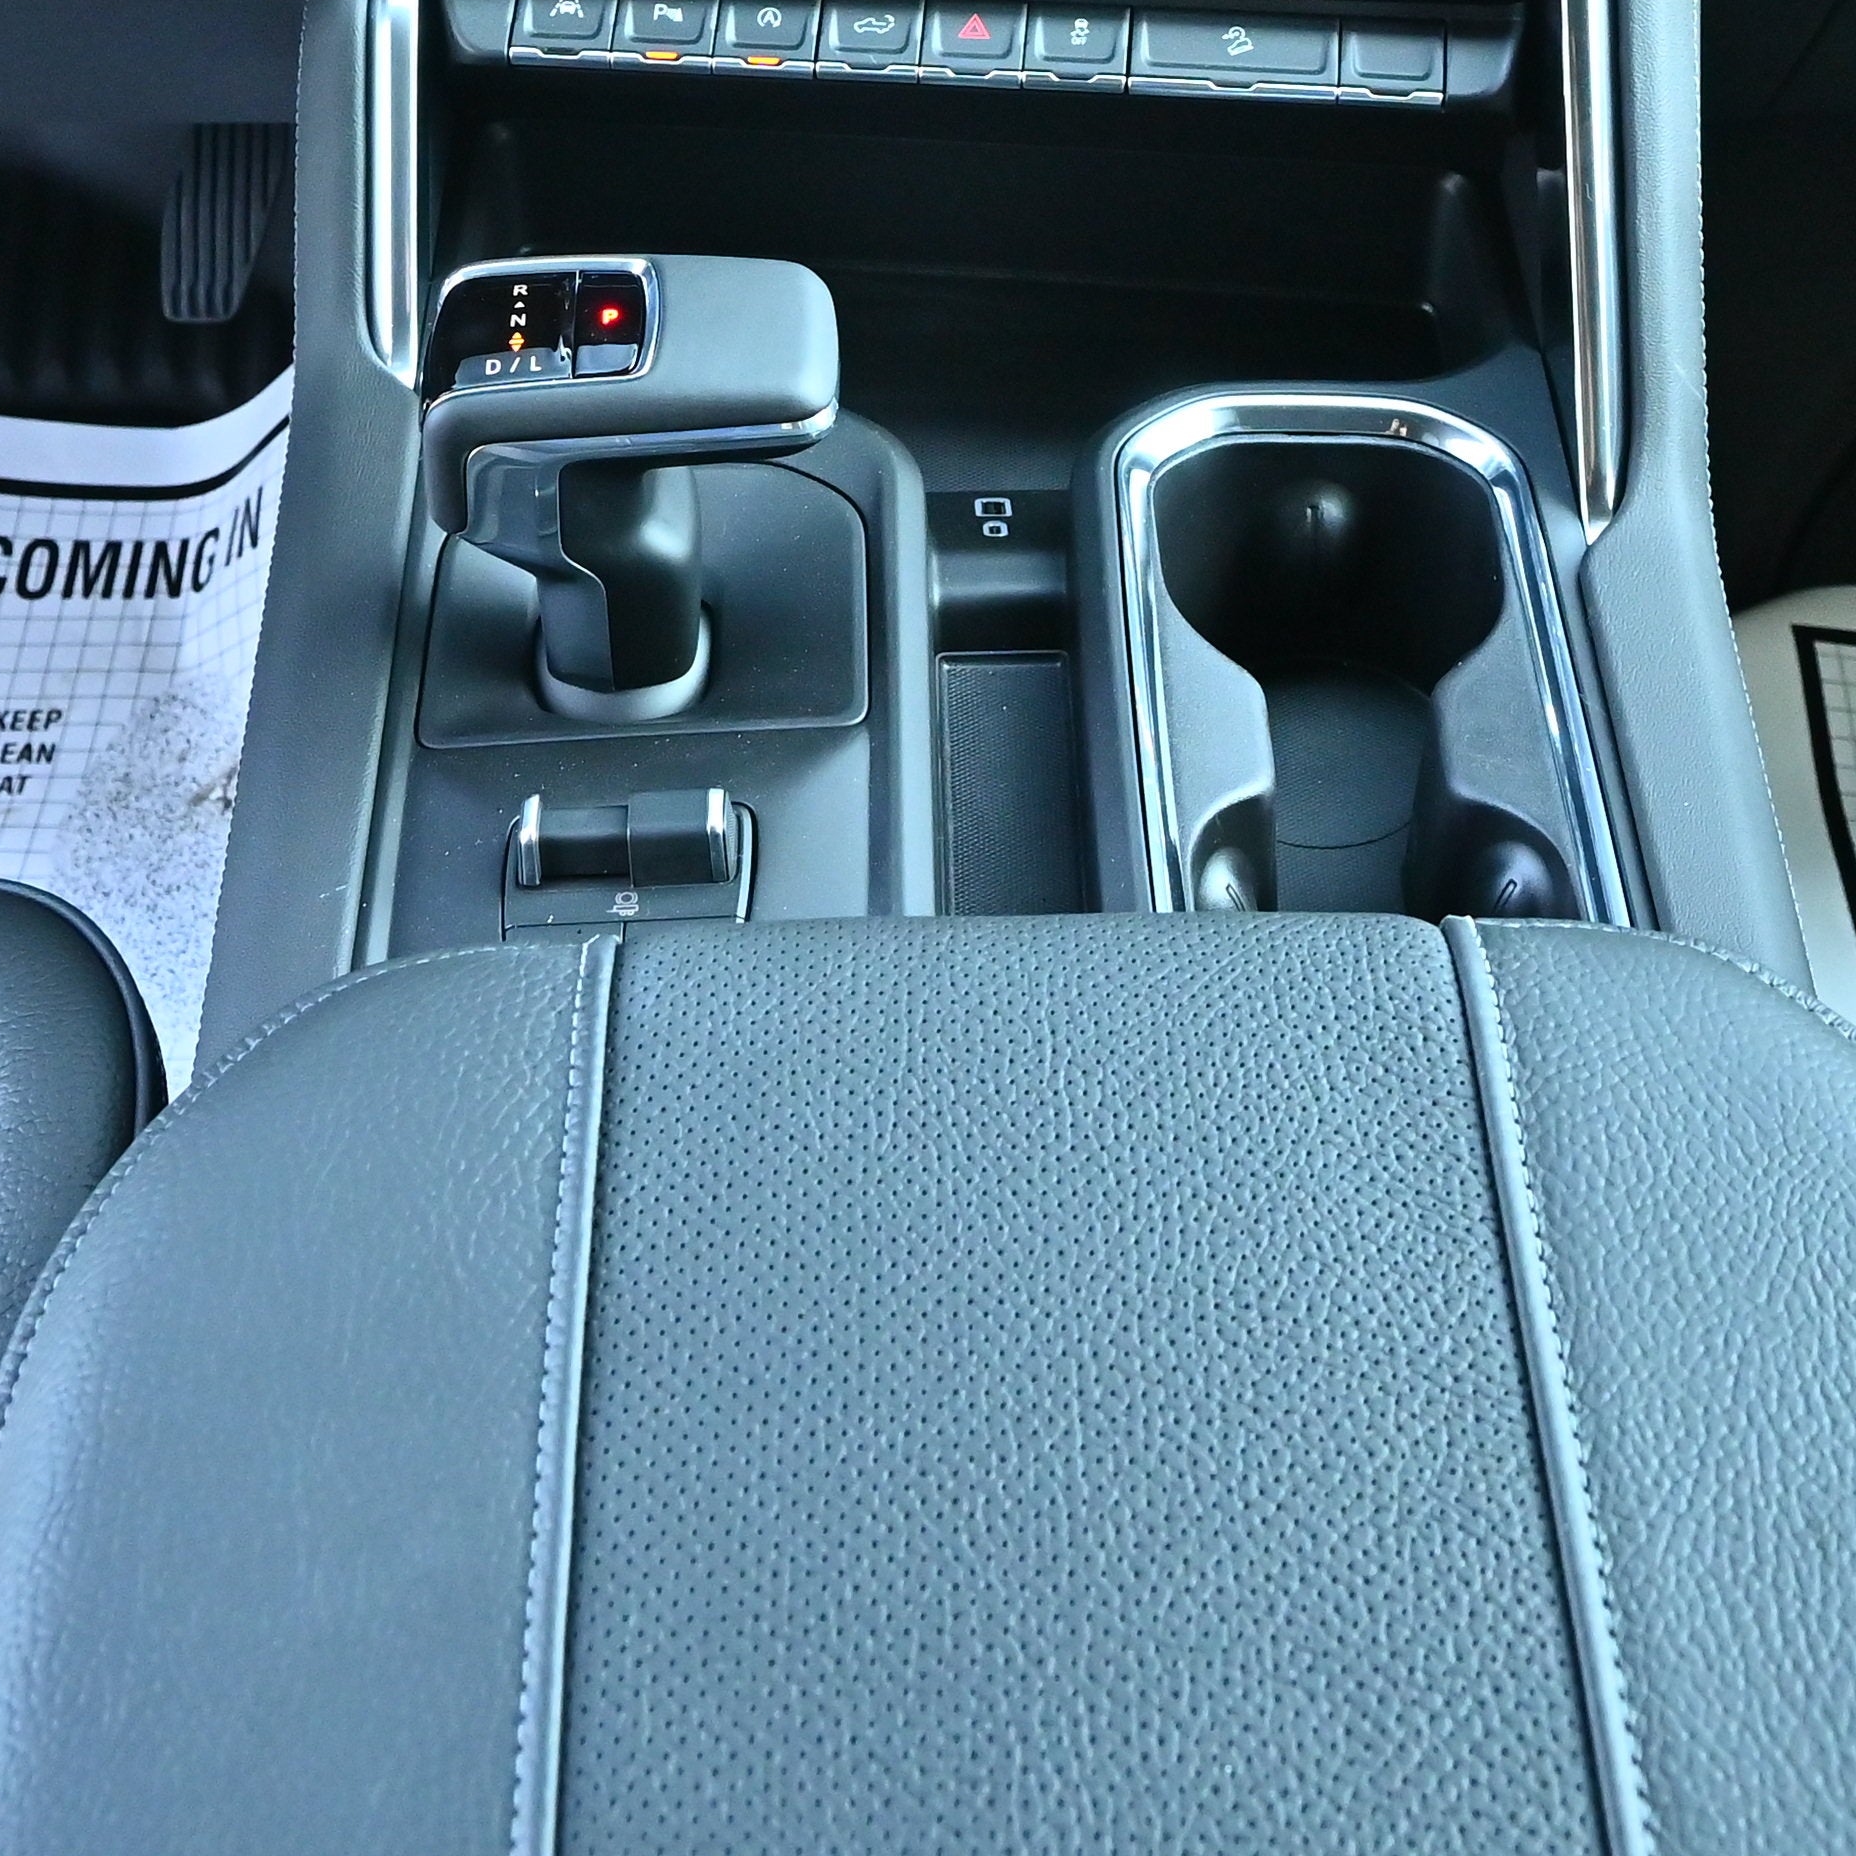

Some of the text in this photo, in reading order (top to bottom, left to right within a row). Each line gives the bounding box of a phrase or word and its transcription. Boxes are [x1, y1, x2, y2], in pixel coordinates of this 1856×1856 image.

[1071, 36, 1087, 46] OFF
[512, 284, 529, 297] R
[510, 313, 527, 328] N
[601, 309, 619, 325] P
[225, 485, 264, 566] IN
